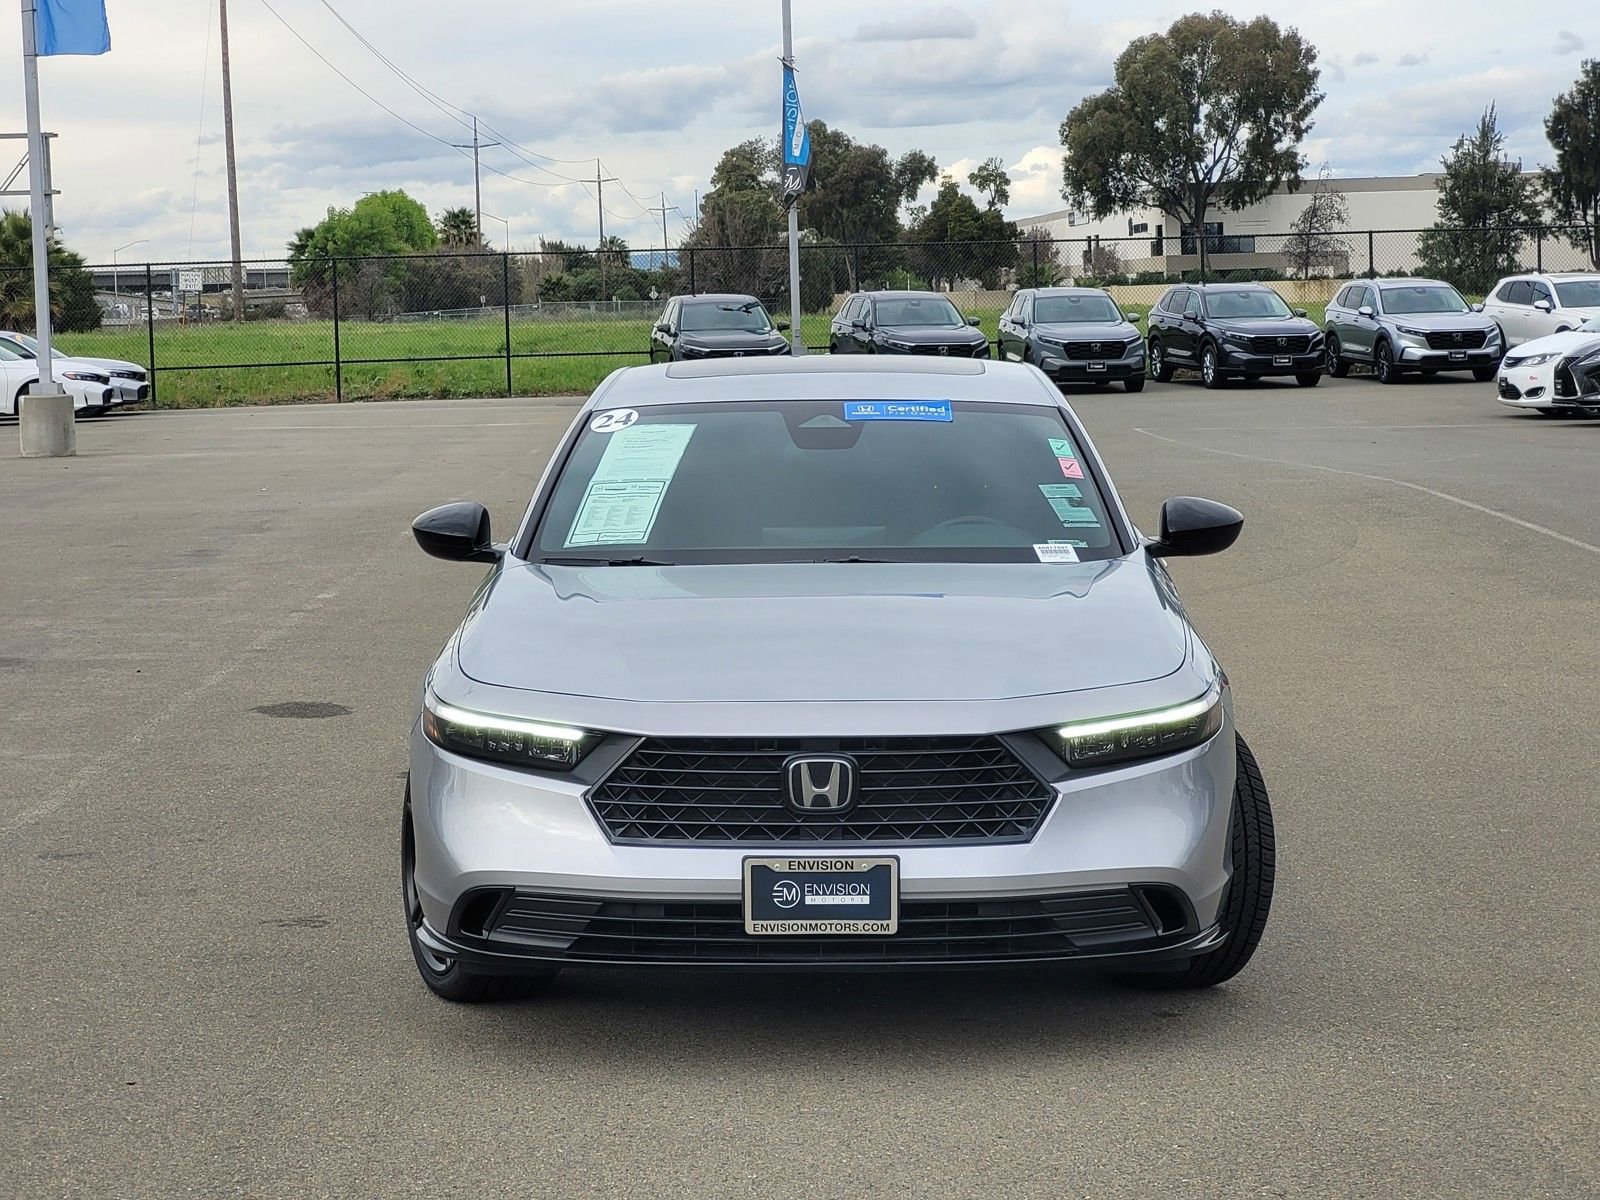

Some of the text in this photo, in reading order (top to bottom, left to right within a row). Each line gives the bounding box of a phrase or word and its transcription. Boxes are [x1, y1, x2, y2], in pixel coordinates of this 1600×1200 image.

[887, 405, 945, 413] Certified
[594, 411, 634, 430] 24
[788, 860, 855, 871] ENVISION
[804, 883, 870, 895] ENVISION
[753, 922, 890, 933] ENVISIONMOTORS.COM
